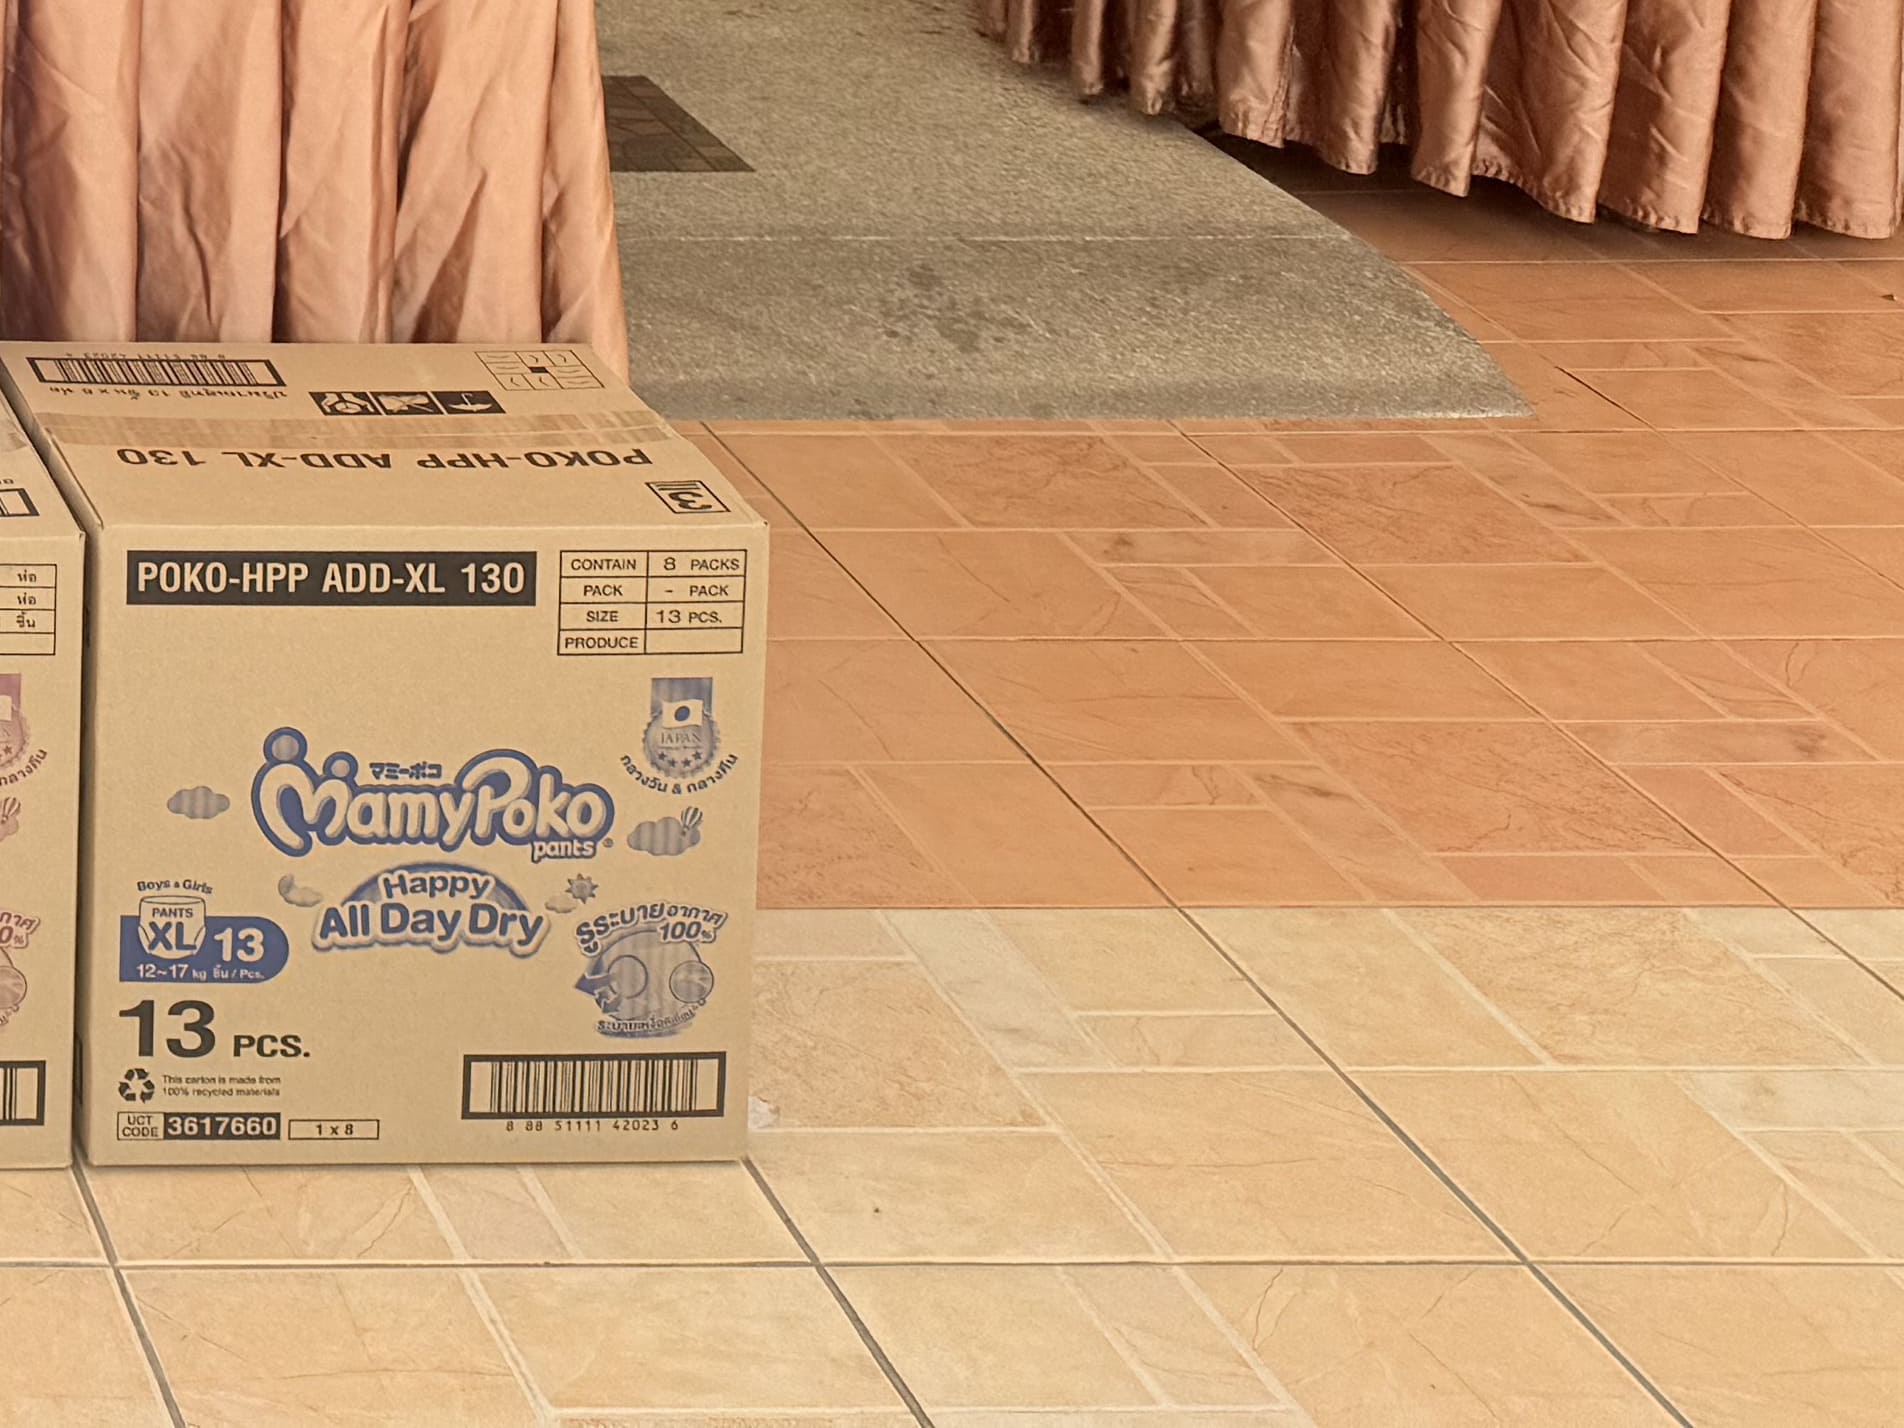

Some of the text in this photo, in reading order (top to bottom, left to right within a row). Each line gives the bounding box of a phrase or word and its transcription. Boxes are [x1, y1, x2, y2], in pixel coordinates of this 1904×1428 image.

[137, 563, 525, 593] POKO-HPP ADD-XL 130
[582, 583, 729, 599] PACK PACK
[564, 635, 640, 652] PRODUCE
[384, 873, 492, 899] Happy
[319, 904, 543, 942] All Day Dry
[148, 921, 265, 962] XL 13
[119, 1000, 310, 1058] 13 PCS.
[167, 1117, 277, 1135] 3617660
